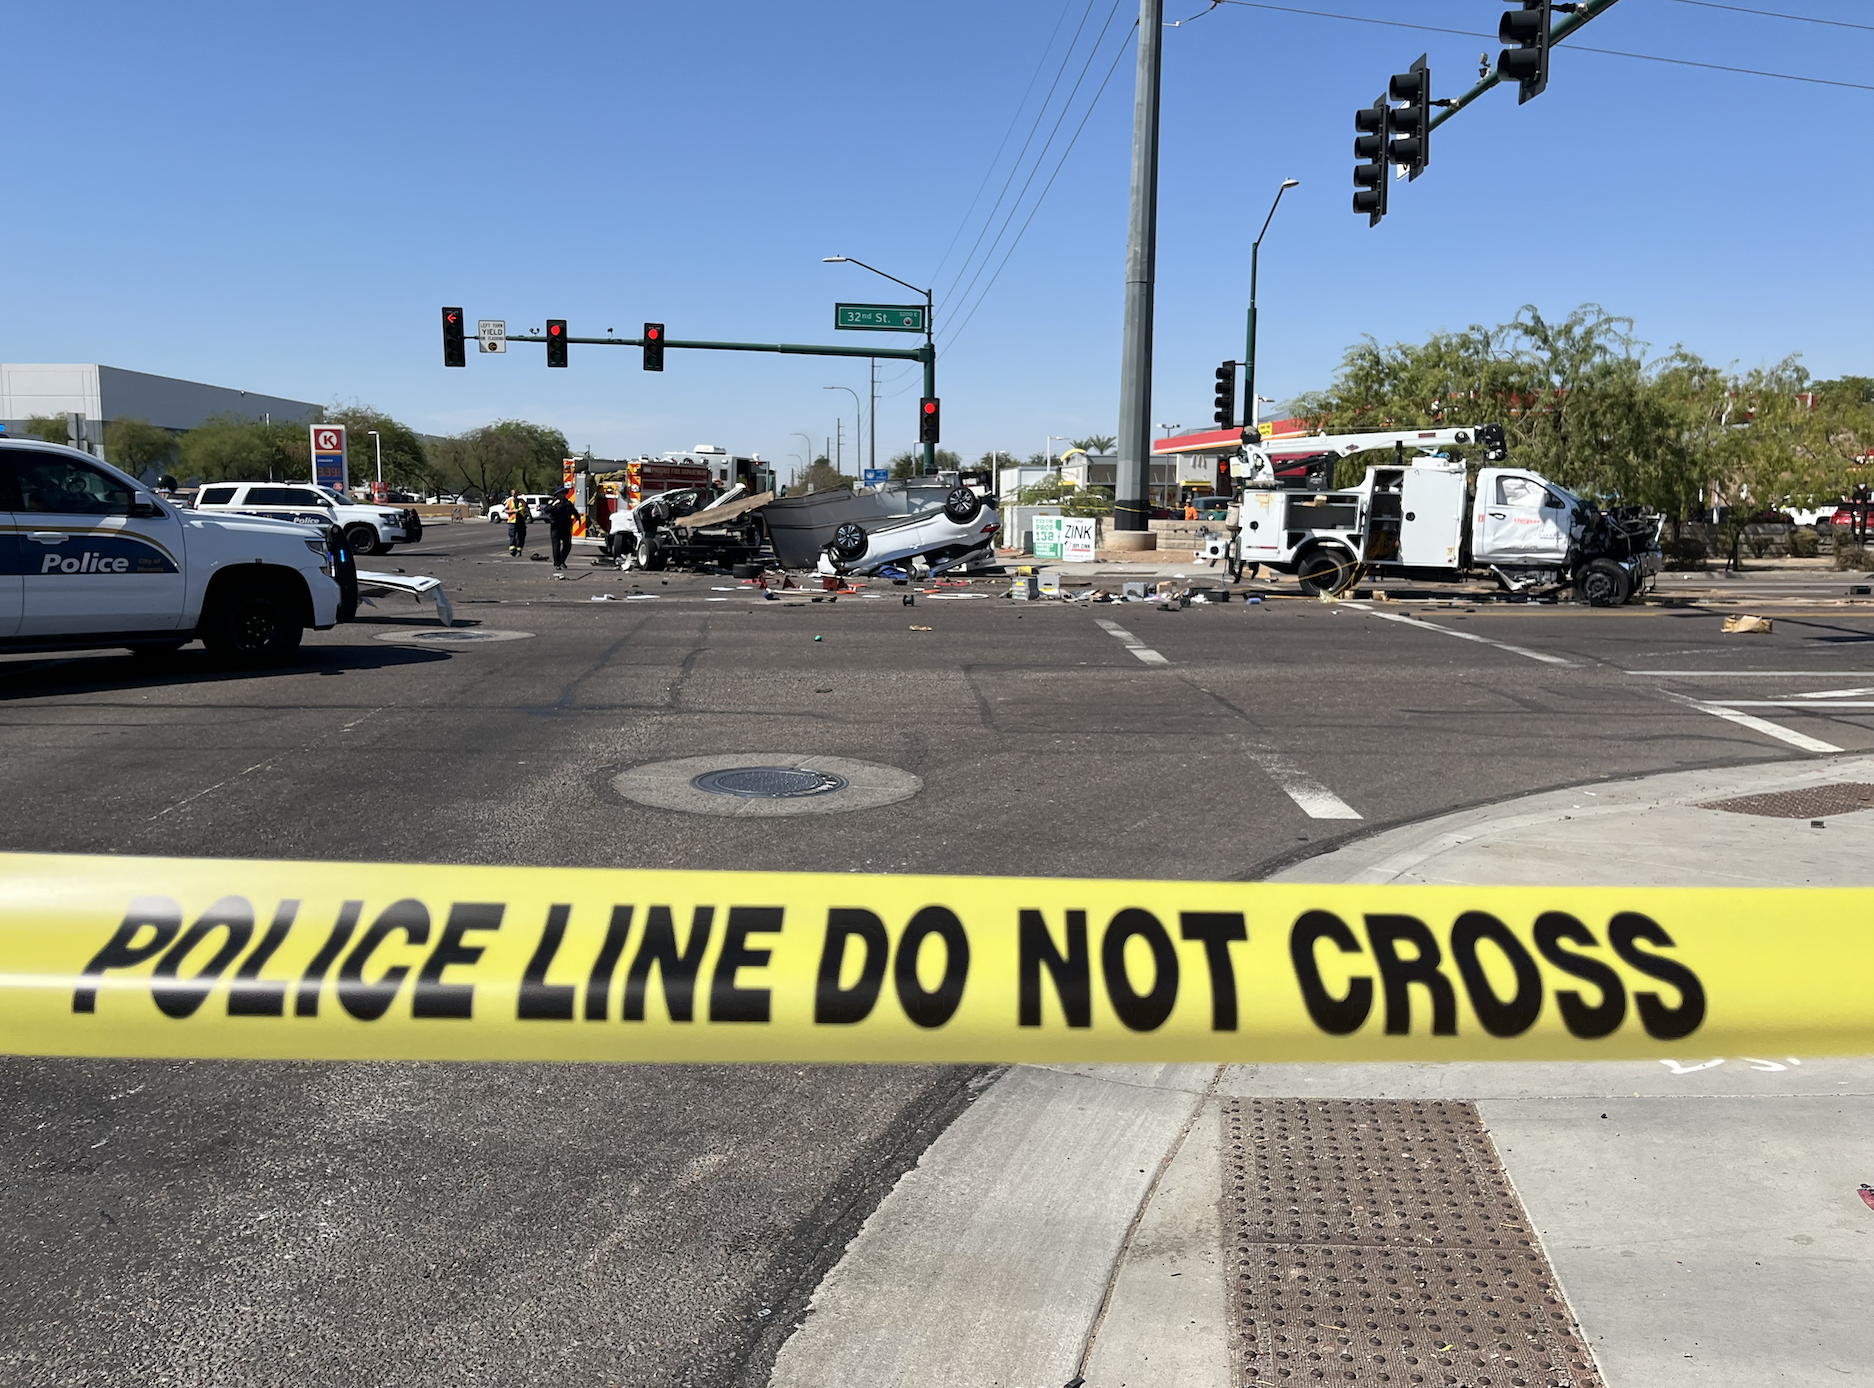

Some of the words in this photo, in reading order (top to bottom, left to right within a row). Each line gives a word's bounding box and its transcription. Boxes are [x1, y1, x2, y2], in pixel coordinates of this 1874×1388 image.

[847, 311, 872, 322] 32nd
[875, 312, 891, 323] St.
[1036, 532, 1054, 541] 138
[1065, 525, 1093, 540] ZINK
[41, 552, 130, 573] Police
[71, 894, 505, 1022] POLICE
[516, 902, 785, 1024] LINE
[814, 905, 970, 1030] DO
[1018, 906, 1248, 1034] NOT
[1289, 909, 1707, 1043] CROSS
